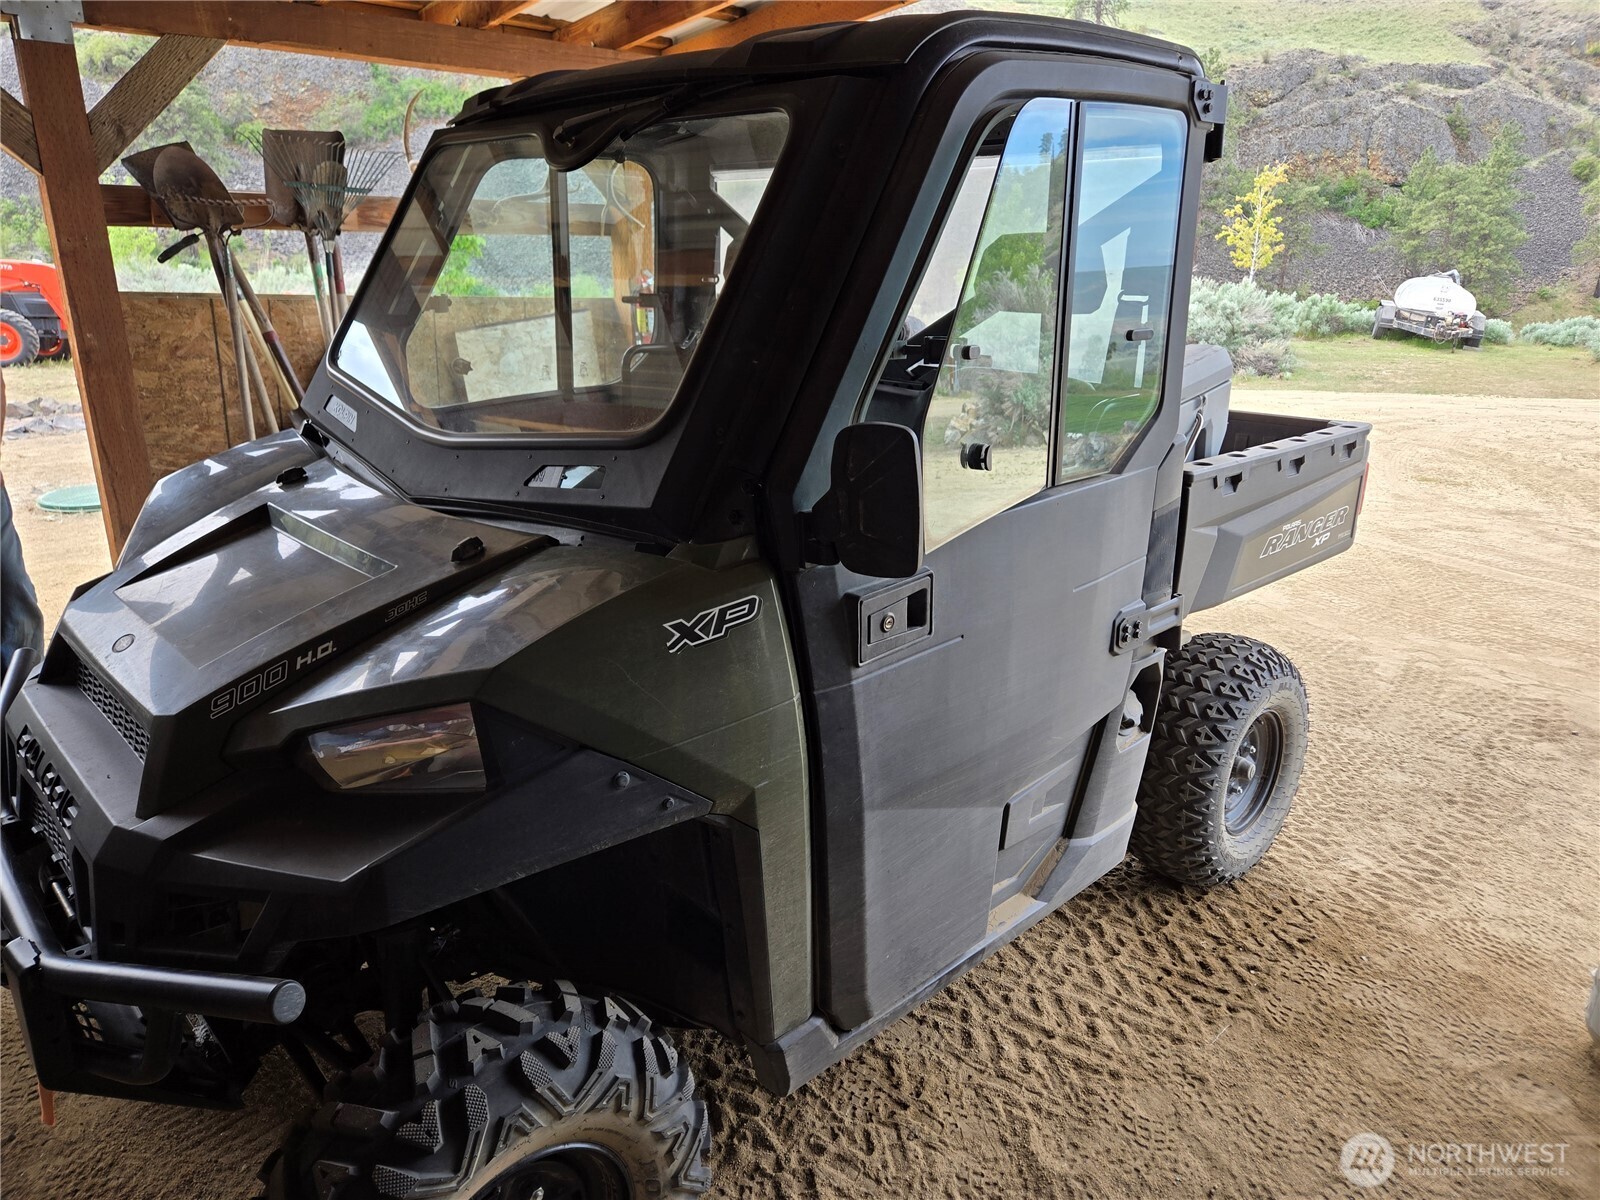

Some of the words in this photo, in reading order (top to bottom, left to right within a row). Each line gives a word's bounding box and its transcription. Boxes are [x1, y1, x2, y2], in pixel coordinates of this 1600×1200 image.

[1259, 505, 1349, 559] RANGER
[1311, 532, 1331, 548] XP
[662, 594, 760, 654] XP
[210, 660, 288, 719] 900
